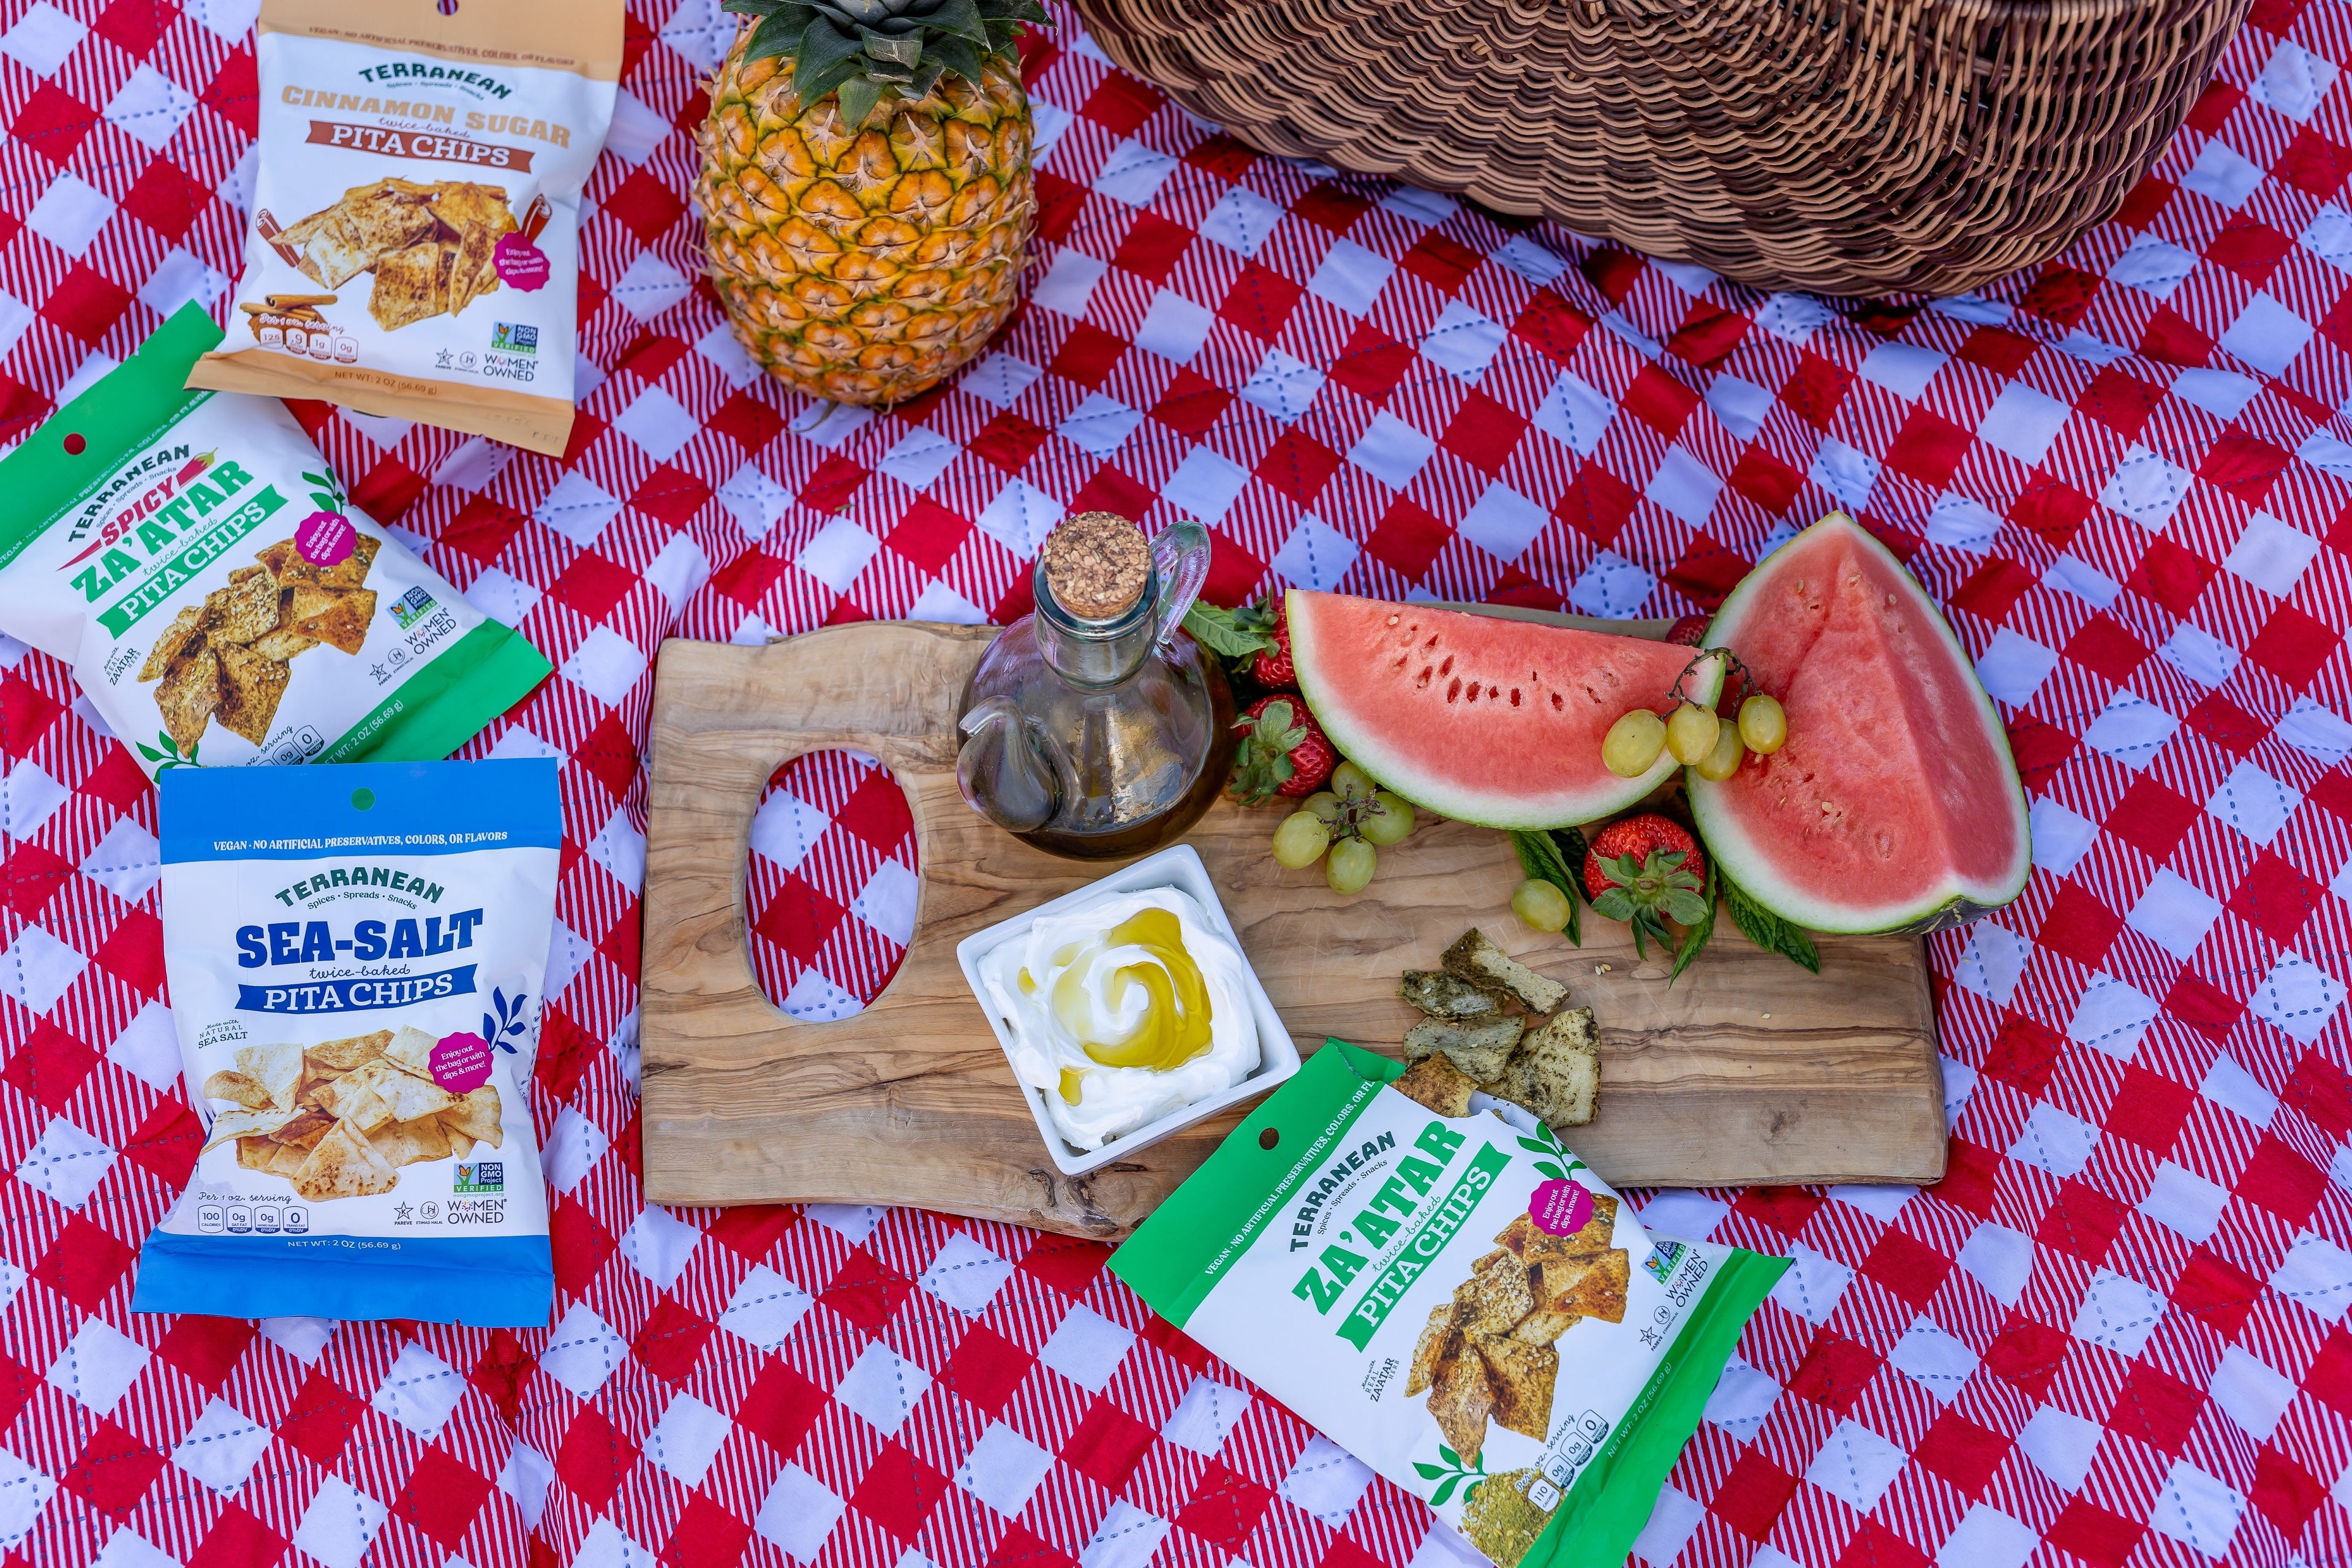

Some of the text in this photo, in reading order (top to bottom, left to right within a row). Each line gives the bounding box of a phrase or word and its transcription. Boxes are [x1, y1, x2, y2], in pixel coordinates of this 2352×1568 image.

[358, 63, 512, 100] TERRANEAN
[281, 85, 571, 149] CINNAMON SUGAR
[379, 116, 471, 139] twice-baked
[330, 124, 511, 167] PITA CHIPS
[518, 325, 537, 334] NON
[315, 339, 325, 349] 1g
[493, 342, 535, 353] VERIFIED
[335, 371, 353, 379] NET
[375, 376, 381, 385] 2
[383, 377, 396, 388] OZ
[484, 365, 534, 382] OWNED
[67, 444, 189, 542] TERRANEAN
[115, 481, 143, 503] Spreads
[149, 466, 177, 481] Snacks
[101, 475, 175, 546] SPICY
[142, 518, 217, 576] twice-baked
[118, 501, 266, 622] PITA CHIPS
[405, 587, 423, 600] NON
[410, 591, 427, 605] GMO
[401, 600, 437, 628] VERIFIED
[413, 618, 456, 655] OWNED
[106, 657, 120, 677] REAL
[127, 651, 141, 669] HERB
[301, 733, 312, 745] 0
[335, 699, 404, 759] WT: 2 OZ (56.69 g)
[260, 725, 293, 755] serving
[280, 750, 293, 762] 0g
[214, 831, 508, 851] VEGAN NO ARTIFICIAL PRESERVATIVES, COLORS, OR FLAVORS
[274, 867, 445, 908] TERRANEAN
[307, 891, 417, 910] Spices Spreads Snacks
[236, 908, 483, 968] SEA-SALT
[309, 963, 411, 979] twice-baked
[263, 973, 453, 1011] PITA CHIPS
[198, 1031, 248, 1049] SEA SALT
[199, 1024, 243, 1039] NATURAL
[435, 1063, 448, 1072] the
[447, 1058, 462, 1068] bag
[469, 1050, 486, 1061] with
[441, 1044, 475, 1060] Enjoy out
[443, 1069, 459, 1080] dips
[465, 1060, 486, 1072] more!
[1204, 1090, 1366, 1275] VEGAN NO ARTIFICIAL PRESERVATIVES, COLORS, OR
[1290, 1131, 1396, 1252] TERRANEAN
[198, 1191, 219, 1200] Per
[249, 1194, 293, 1205] serving
[1317, 1160, 1388, 1235] Spices Spreads Snacks
[1542, 1188, 1559, 1219] Enjoy out
[1550, 1184, 1572, 1230] the bag or with
[202, 1212, 220, 1221] 100
[232, 1213, 246, 1223] 0g
[260, 1213, 274, 1223] 0g
[290, 1212, 301, 1224] 0
[448, 1212, 504, 1225] OWNED
[1560, 1214, 1571, 1229] dips
[1568, 1189, 1580, 1209] more!
[341, 1240, 355, 1248] OZ
[1371, 1196, 1441, 1272] twice-baked
[1355, 1166, 1491, 1328] PITA CHIPS
[1660, 1245, 1686, 1282] VERIFIED
[1676, 1260, 1708, 1308] OWNED
[1651, 1335, 1664, 1352] PAREVE
[1388, 1360, 1400, 1380] HERB
[1365, 1370, 1379, 1393] REAL
[1608, 1362, 1673, 1458] NET WT: 2 OZ (56.69 g)
[1585, 1419, 1597, 1431] 0
[1515, 1472, 1532, 1492] Per
[1547, 1414, 1575, 1450] serving
[1568, 1441, 1582, 1455] 0g
[1551, 1463, 1565, 1477] 0g
[1534, 1485, 1548, 1502] 110
[1542, 1490, 1556, 1509] CALORIES
